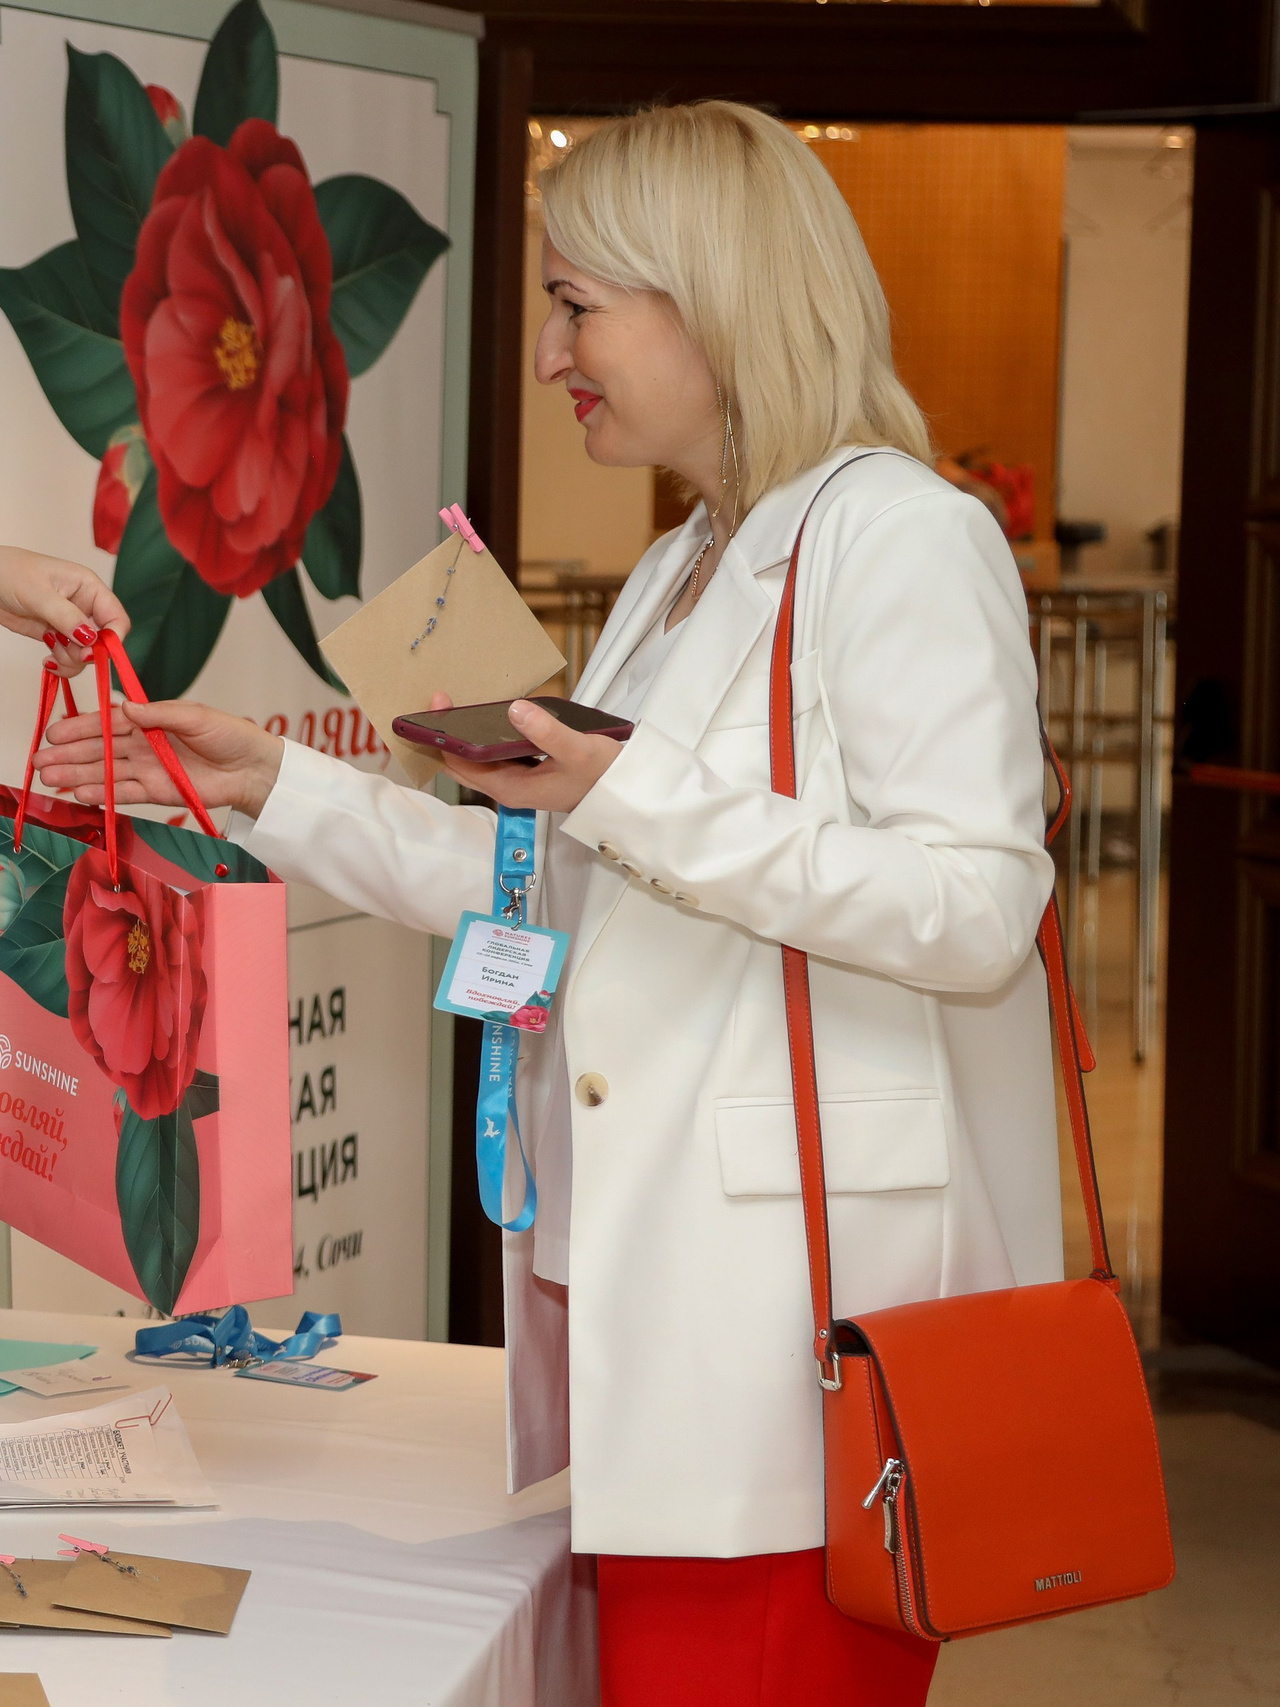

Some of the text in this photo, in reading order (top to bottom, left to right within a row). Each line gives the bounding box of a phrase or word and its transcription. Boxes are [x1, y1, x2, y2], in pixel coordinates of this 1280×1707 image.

[15, 1050, 80, 1097] SUNSHINE
[489, 1025, 503, 1082] NSHINE
[1034, 1570, 1082, 1592] MATTIOLI
